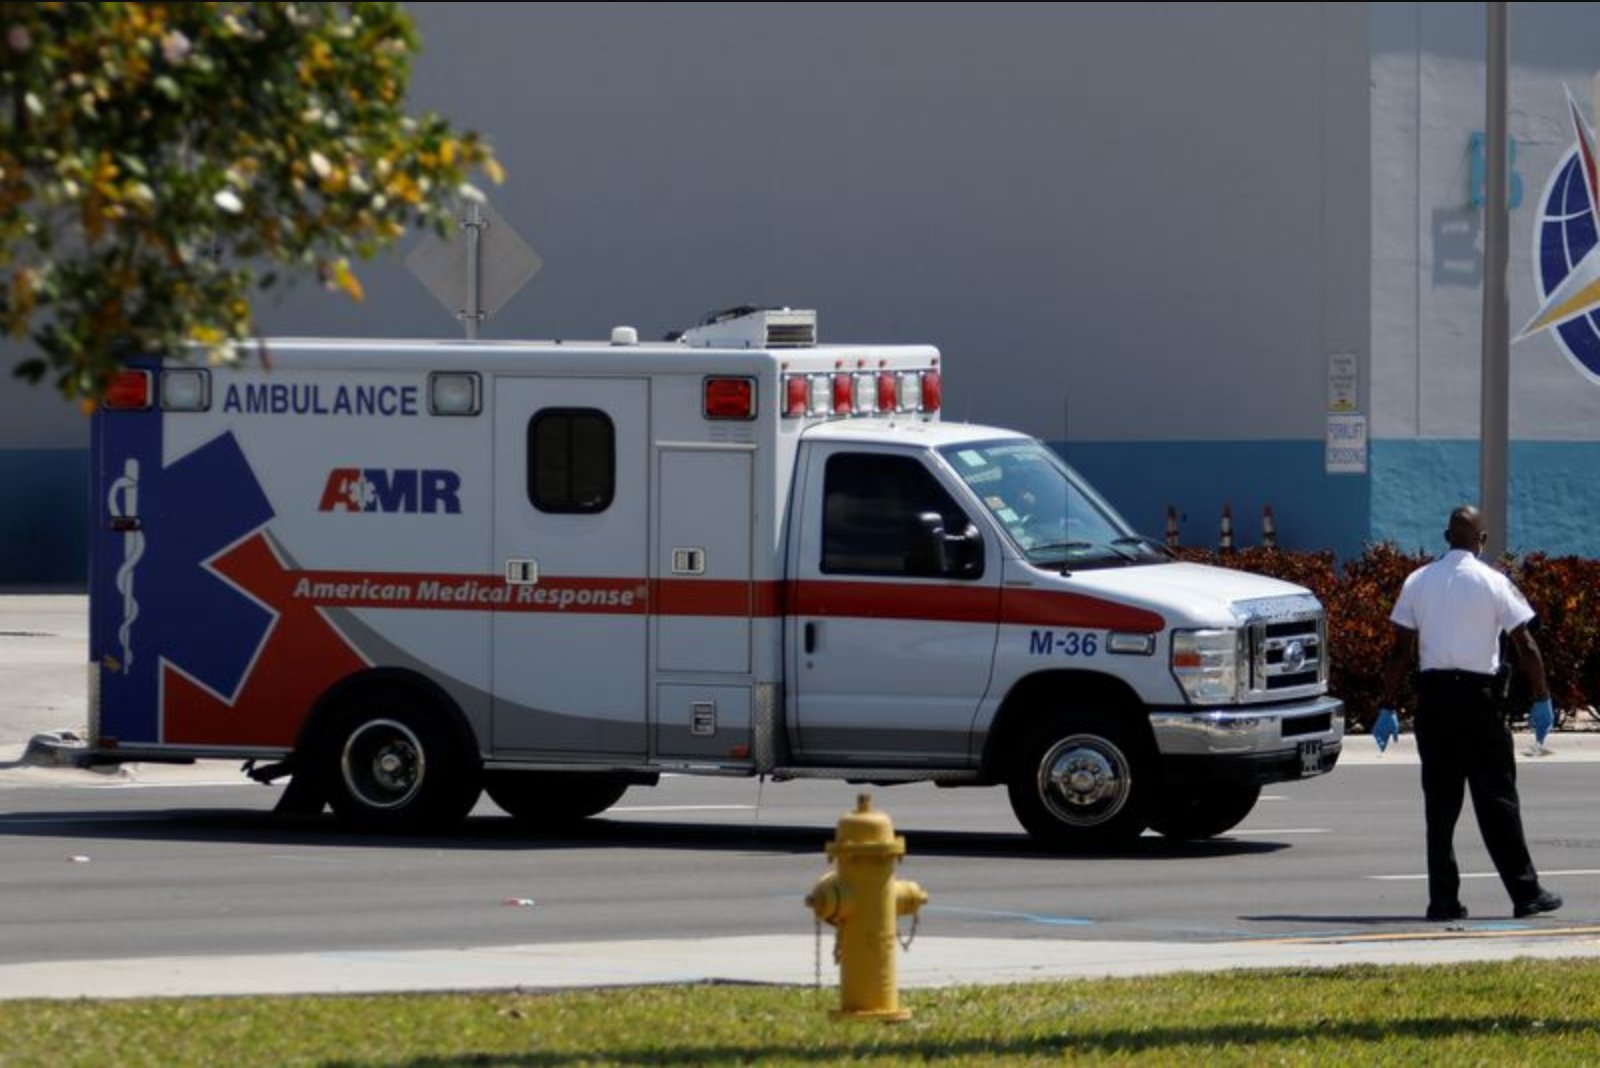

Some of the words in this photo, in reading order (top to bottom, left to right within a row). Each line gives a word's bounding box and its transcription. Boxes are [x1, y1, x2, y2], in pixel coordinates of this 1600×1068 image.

[223, 383, 418, 416] AMBULANCE
[318, 468, 462, 514] AMR
[294, 577, 411, 600] American
[416, 580, 512, 602] Medical
[1030, 630, 1098, 656] M-36
